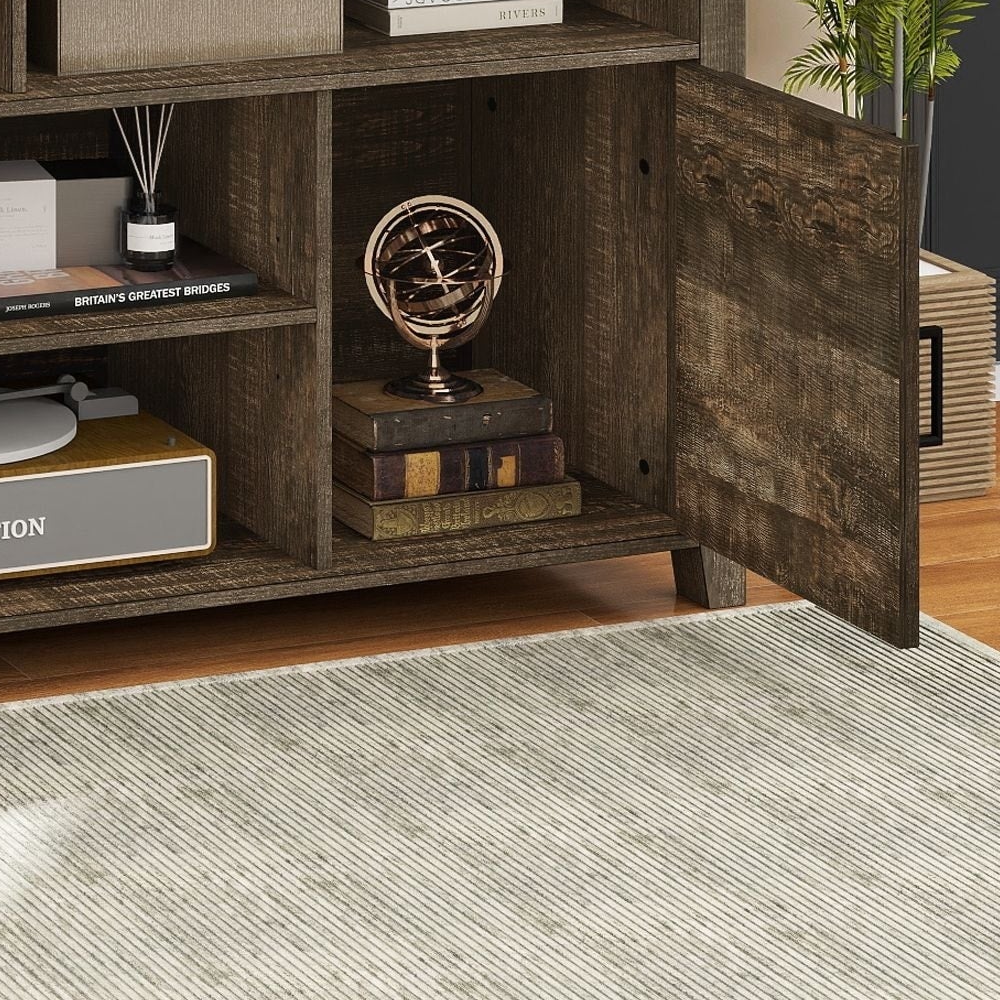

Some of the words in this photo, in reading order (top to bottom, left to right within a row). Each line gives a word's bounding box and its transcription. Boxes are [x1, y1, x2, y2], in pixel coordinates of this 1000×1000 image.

[499, 7, 546, 20] RIVERS
[74, 292, 126, 307] BRITAIN'S
[128, 286, 182, 302] GREATEST
[183, 282, 231, 297] BRIDGES
[5, 304, 27, 313] JOSEPH
[28, 302, 51, 310] ROGERS
